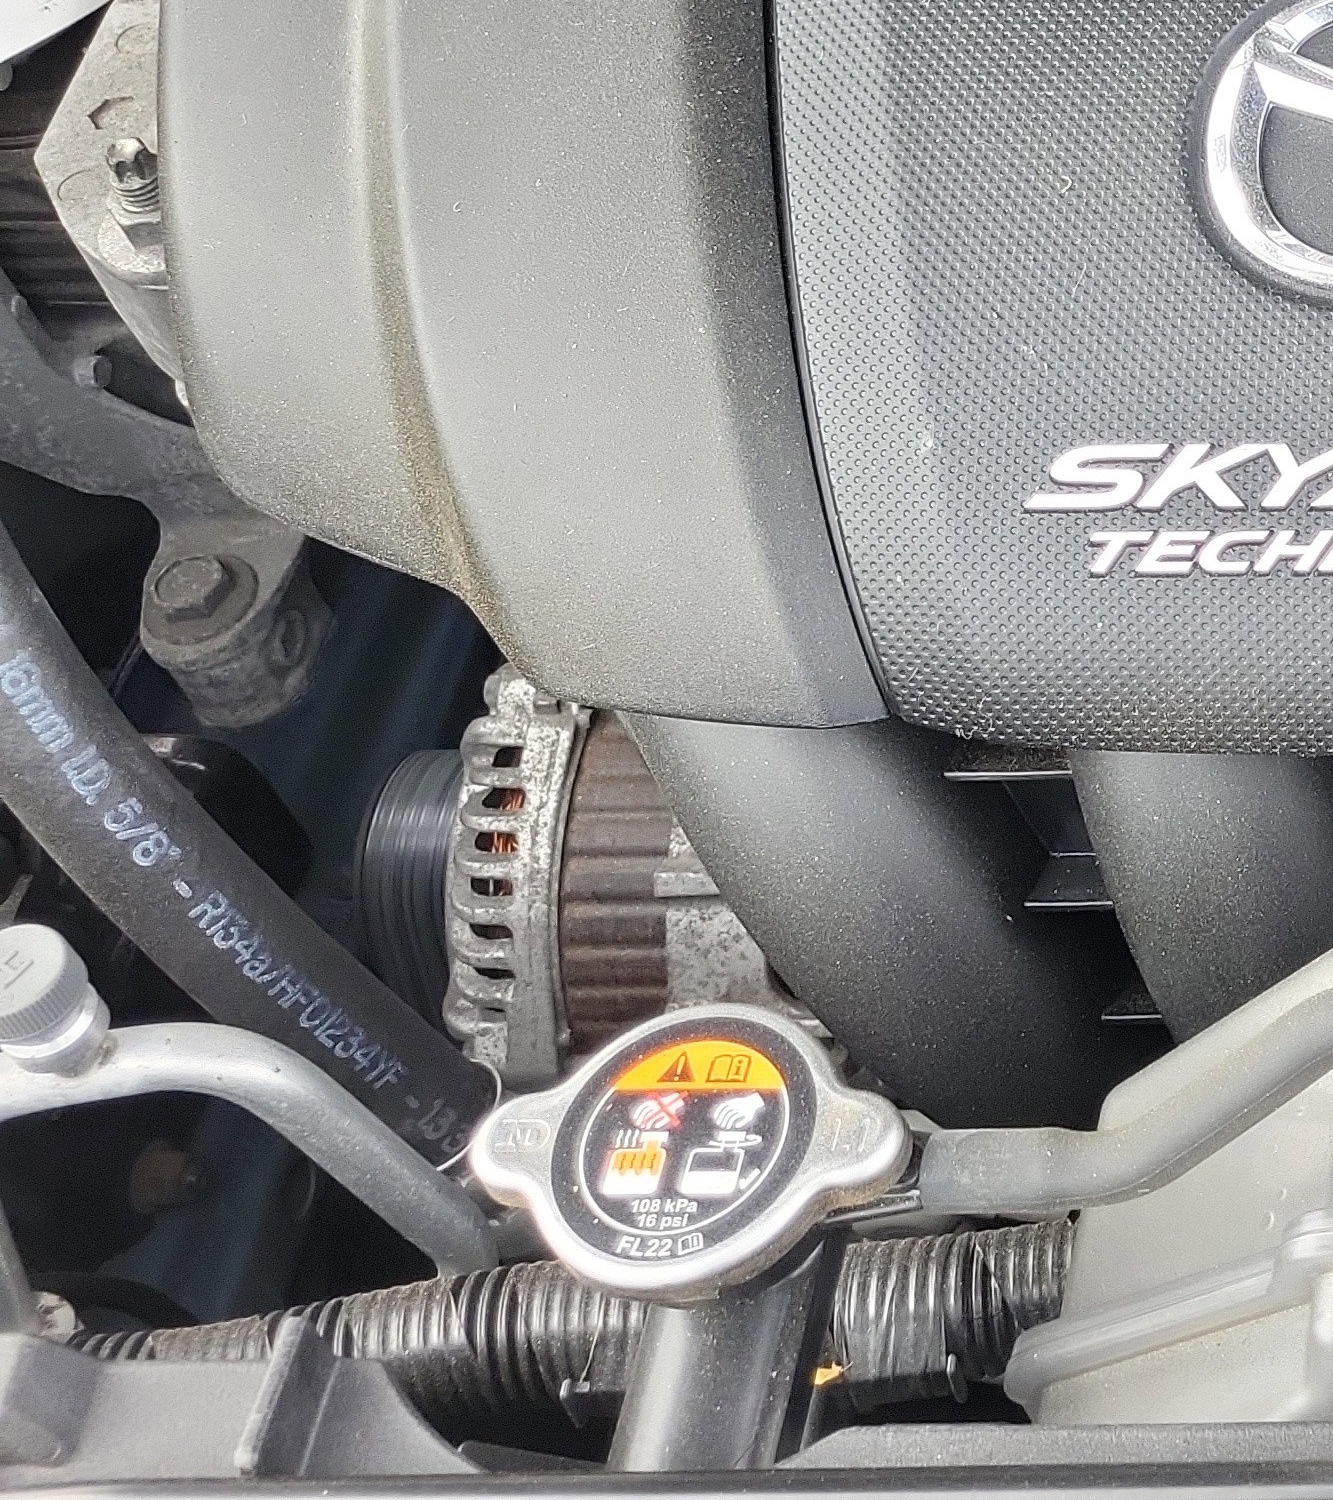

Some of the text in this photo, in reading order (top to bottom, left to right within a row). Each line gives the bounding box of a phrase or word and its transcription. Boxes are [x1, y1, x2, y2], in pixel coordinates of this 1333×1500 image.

[630, 1198, 699, 1214] 108 kPa
[637, 1212, 690, 1230] 16 psi
[615, 1234, 674, 1258] FL22
